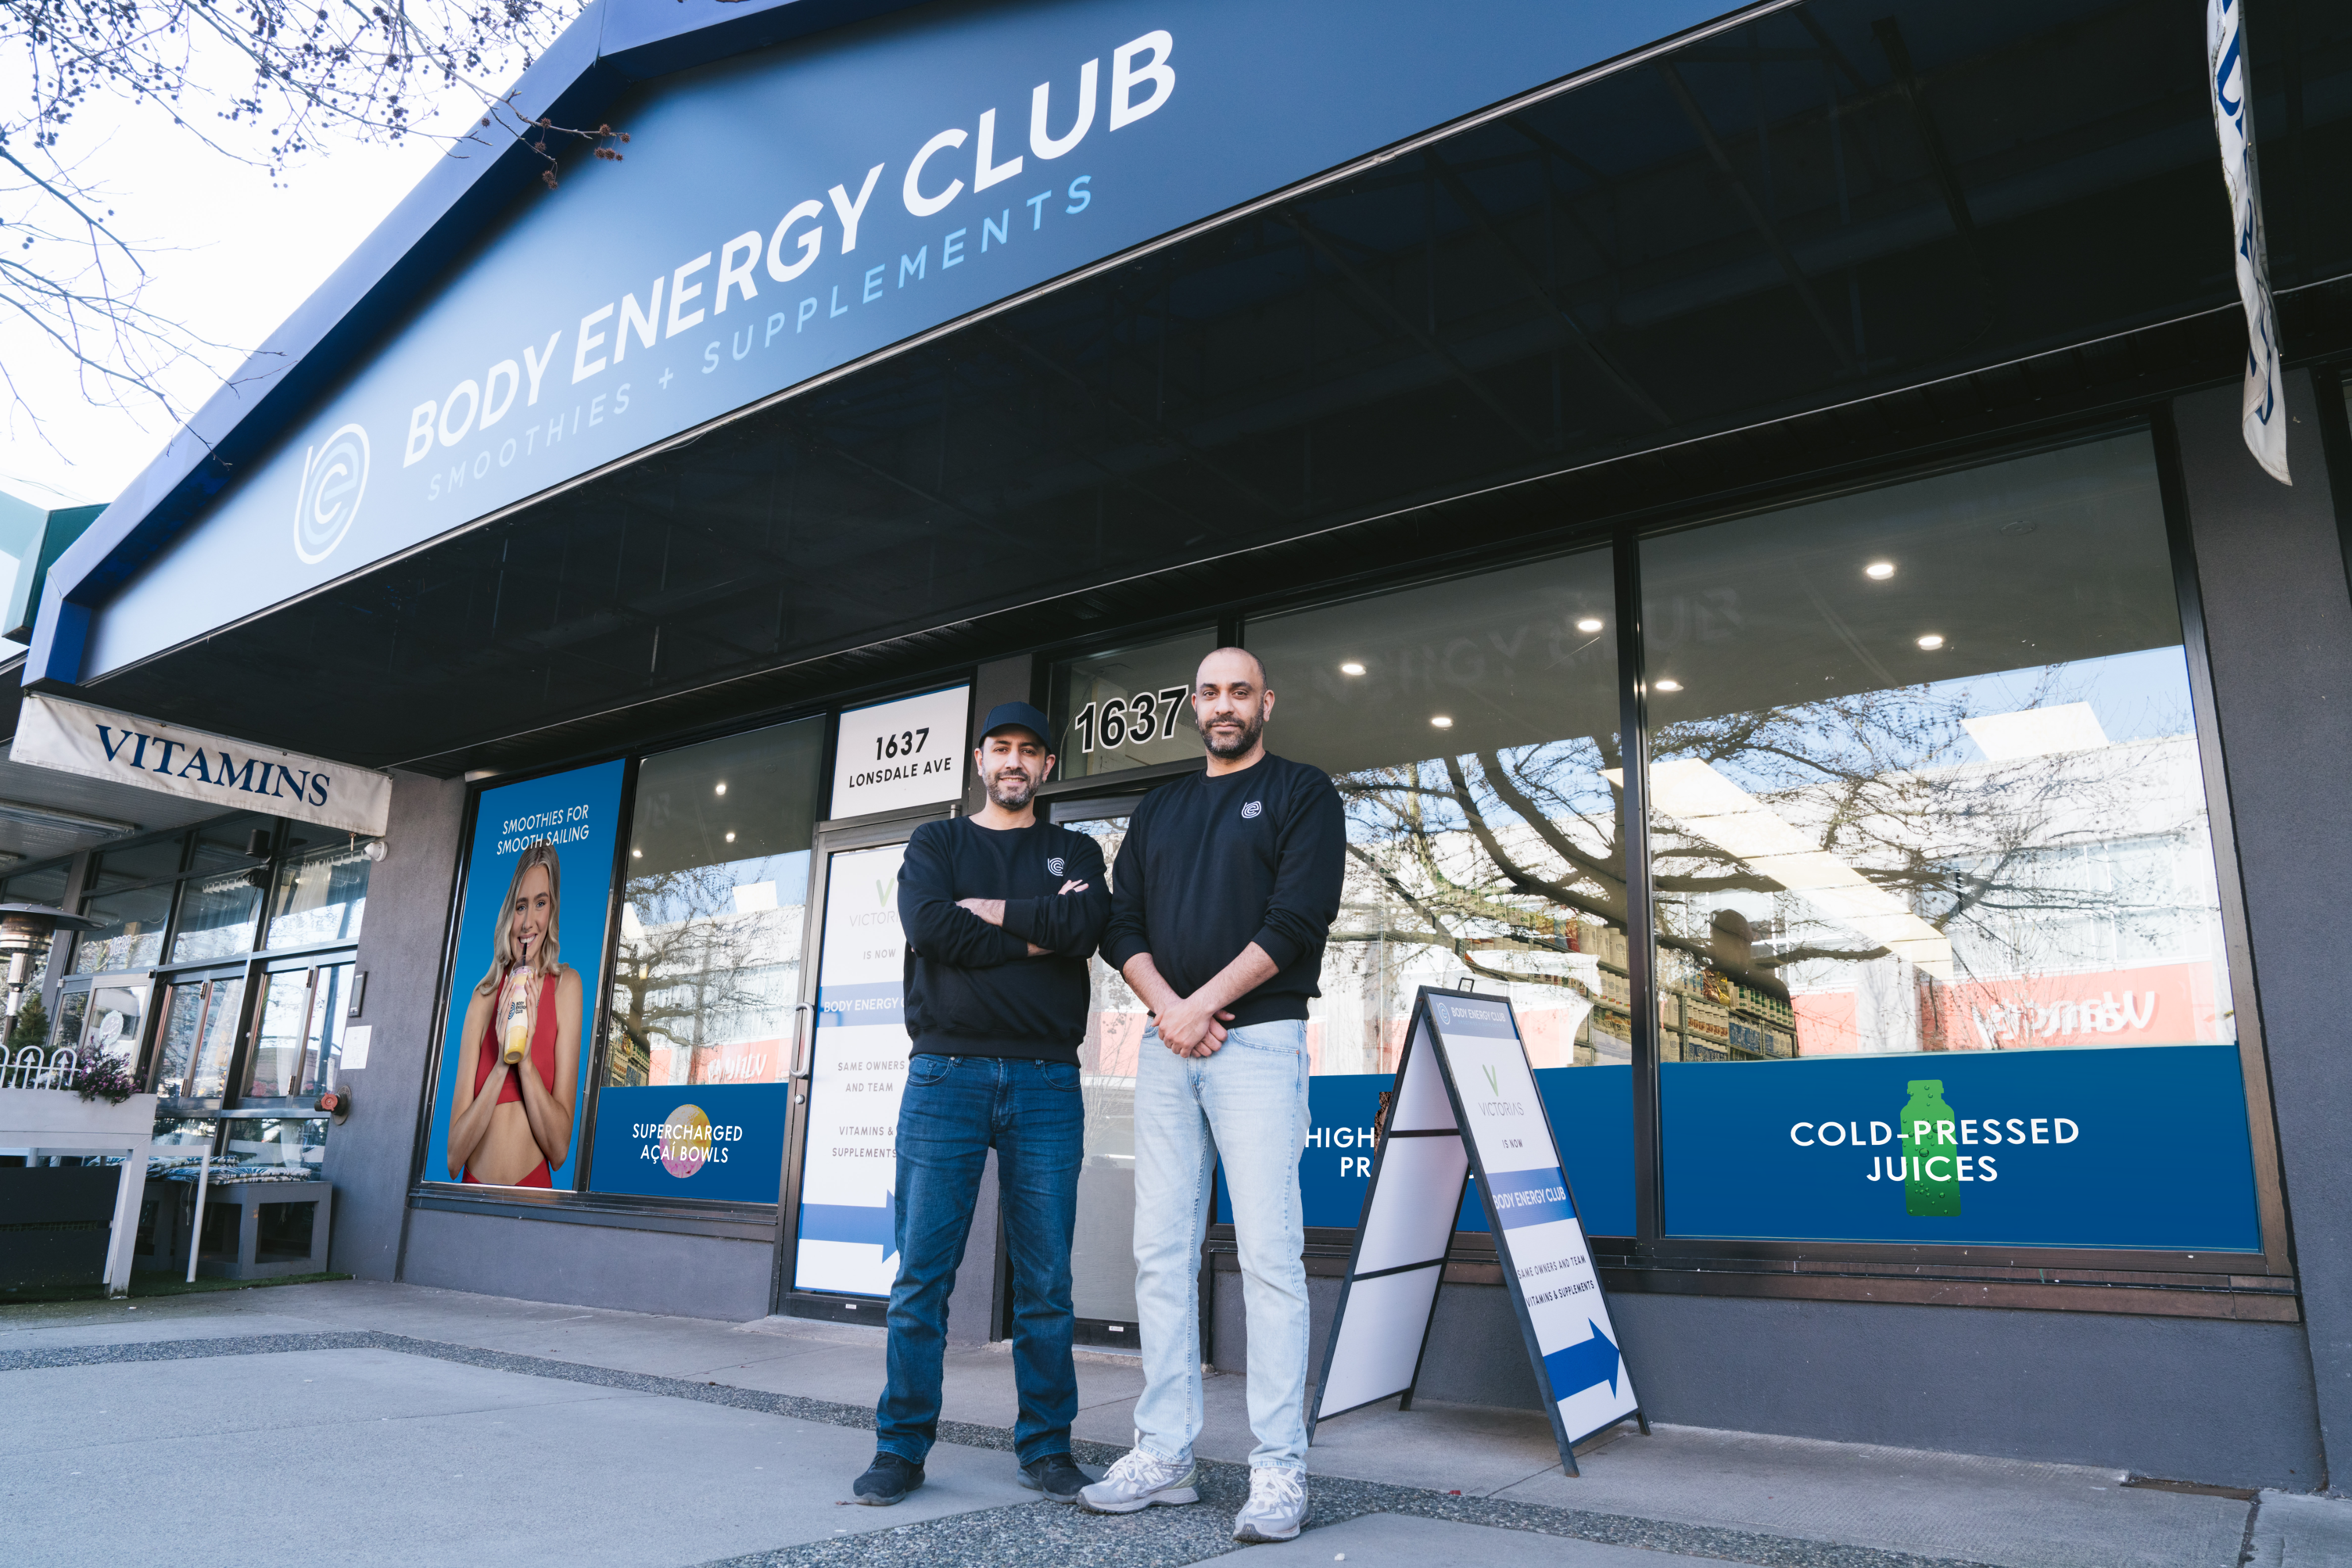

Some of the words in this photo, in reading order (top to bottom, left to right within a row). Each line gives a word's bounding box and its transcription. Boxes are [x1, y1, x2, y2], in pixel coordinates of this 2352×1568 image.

[402, 330, 562, 469] BODY
[572, 162, 885, 385] ENERGY
[903, 30, 1175, 217] CLUB
[427, 383, 632, 502] SMOOTHIES
[702, 175, 1092, 374] SUPPLEMENTS
[1075, 684, 1189, 753] 1637
[876, 727, 930, 760] 1637
[95, 724, 330, 807] VITAMINS
[849, 764, 918, 788] LONSDALE
[923, 757, 951, 775] AVE
[502, 809, 564, 835] SMOOTHIES
[567, 804, 589, 822] FOR
[497, 833, 543, 855] SMOOTH
[546, 824, 589, 846] SAILING
[110, 934, 132, 955] 1629
[863, 951, 872, 959] IS
[875, 948, 896, 959] NOW
[823, 1000, 853, 1013] BODY
[854, 997, 899, 1011] ENERGY
[1450, 1006, 1467, 1018] BODY
[1468, 1009, 1491, 1021] ENERGY
[1491, 1011, 1506, 1022] CLUB
[838, 1062, 863, 1071] SAME
[866, 1060, 905, 1070] OWNERS
[845, 1083, 864, 1092] AND
[868, 1083, 893, 1091] TEAM
[632, 1123, 742, 1141] SUPERCHARGED
[839, 1126, 884, 1136] VITAMINS
[888, 1126, 893, 1136] &
[1790, 1117, 2080, 1147] COLD-PRESSED
[640, 1141, 676, 1164] AÇAÍ
[680, 1146, 729, 1163] BOWLS
[832, 1148, 896, 1157] SUPPLEMENTS
[1502, 1139, 1508, 1148] IS
[1510, 1139, 1523, 1148] NOW
[1866, 1155, 1998, 1182] JUICES
[1492, 1193, 1515, 1210] BODY
[1514, 1188, 1546, 1207] ENERGY
[1545, 1186, 1566, 1202] CLUB
[1517, 1267, 1534, 1279] SAME
[1534, 1261, 1557, 1275] OWNERS
[1558, 1259, 1570, 1269] AND
[1570, 1255, 1587, 1266] TEAM
[1526, 1292, 1553, 1307] VITAMINS
[1553, 1290, 1558, 1300] &
[1558, 1280, 1595, 1298] SUPPLEMENTS
